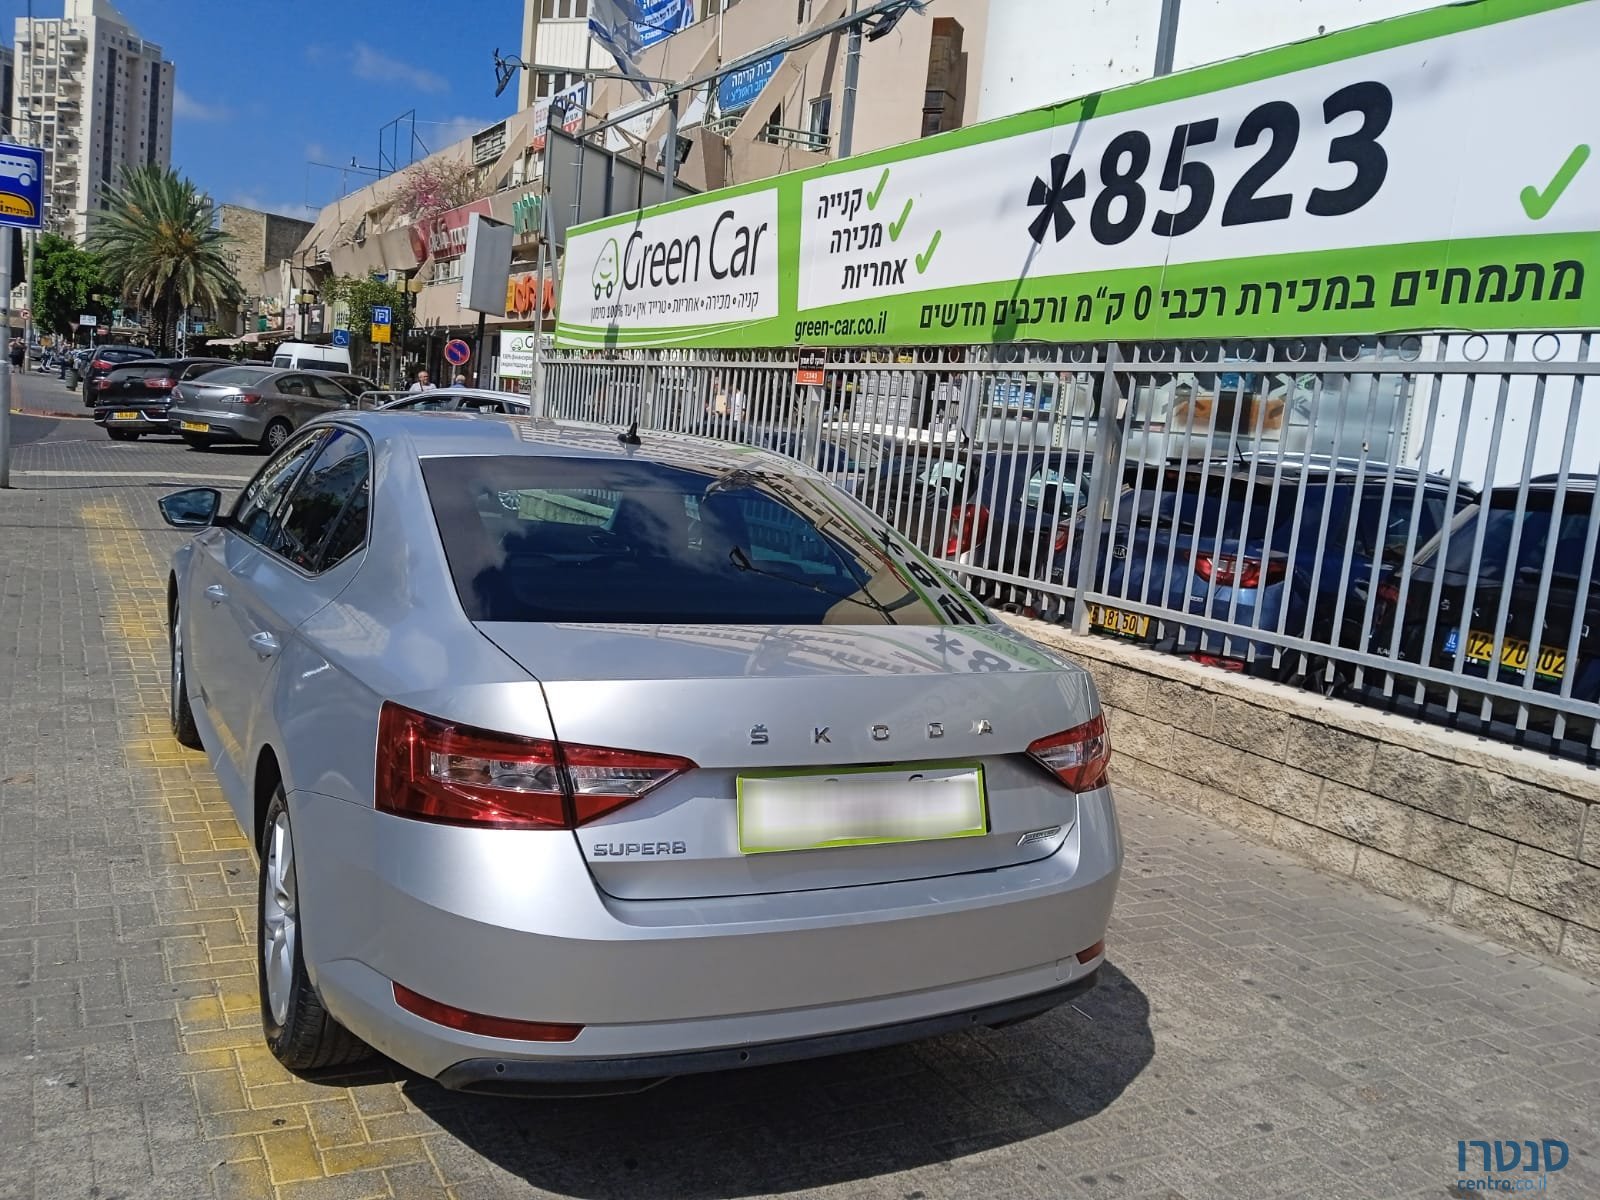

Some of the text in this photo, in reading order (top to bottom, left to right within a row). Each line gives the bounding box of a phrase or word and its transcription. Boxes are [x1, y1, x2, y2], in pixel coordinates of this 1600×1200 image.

[757, 61, 772, 77] בית
[817, 188, 863, 221] קנייה
[623, 210, 767, 291] Green Car
[829, 222, 883, 254] מכירה
[841, 258, 908, 290] אחריות
[1390, 260, 1585, 308] מתמחים
[649, 300, 667, 314] טרייד
[672, 297, 699, 313] אחריות
[706, 294, 730, 310] מכירה
[738, 291, 759, 312] קניה
[1133, 285, 1151, 321] 0
[1160, 285, 1227, 320] רכבי
[1235, 274, 1376, 316] במכירת
[607, 304, 624, 318] 100%
[636, 302, 646, 320] אין
[920, 301, 987, 328] חדשים
[993, 295, 1068, 326] ורכבים
[794, 310, 888, 342] green-car.co.il
[750, 718, 995, 746] ŠKODA
[593, 840, 687, 858] SUPERB
